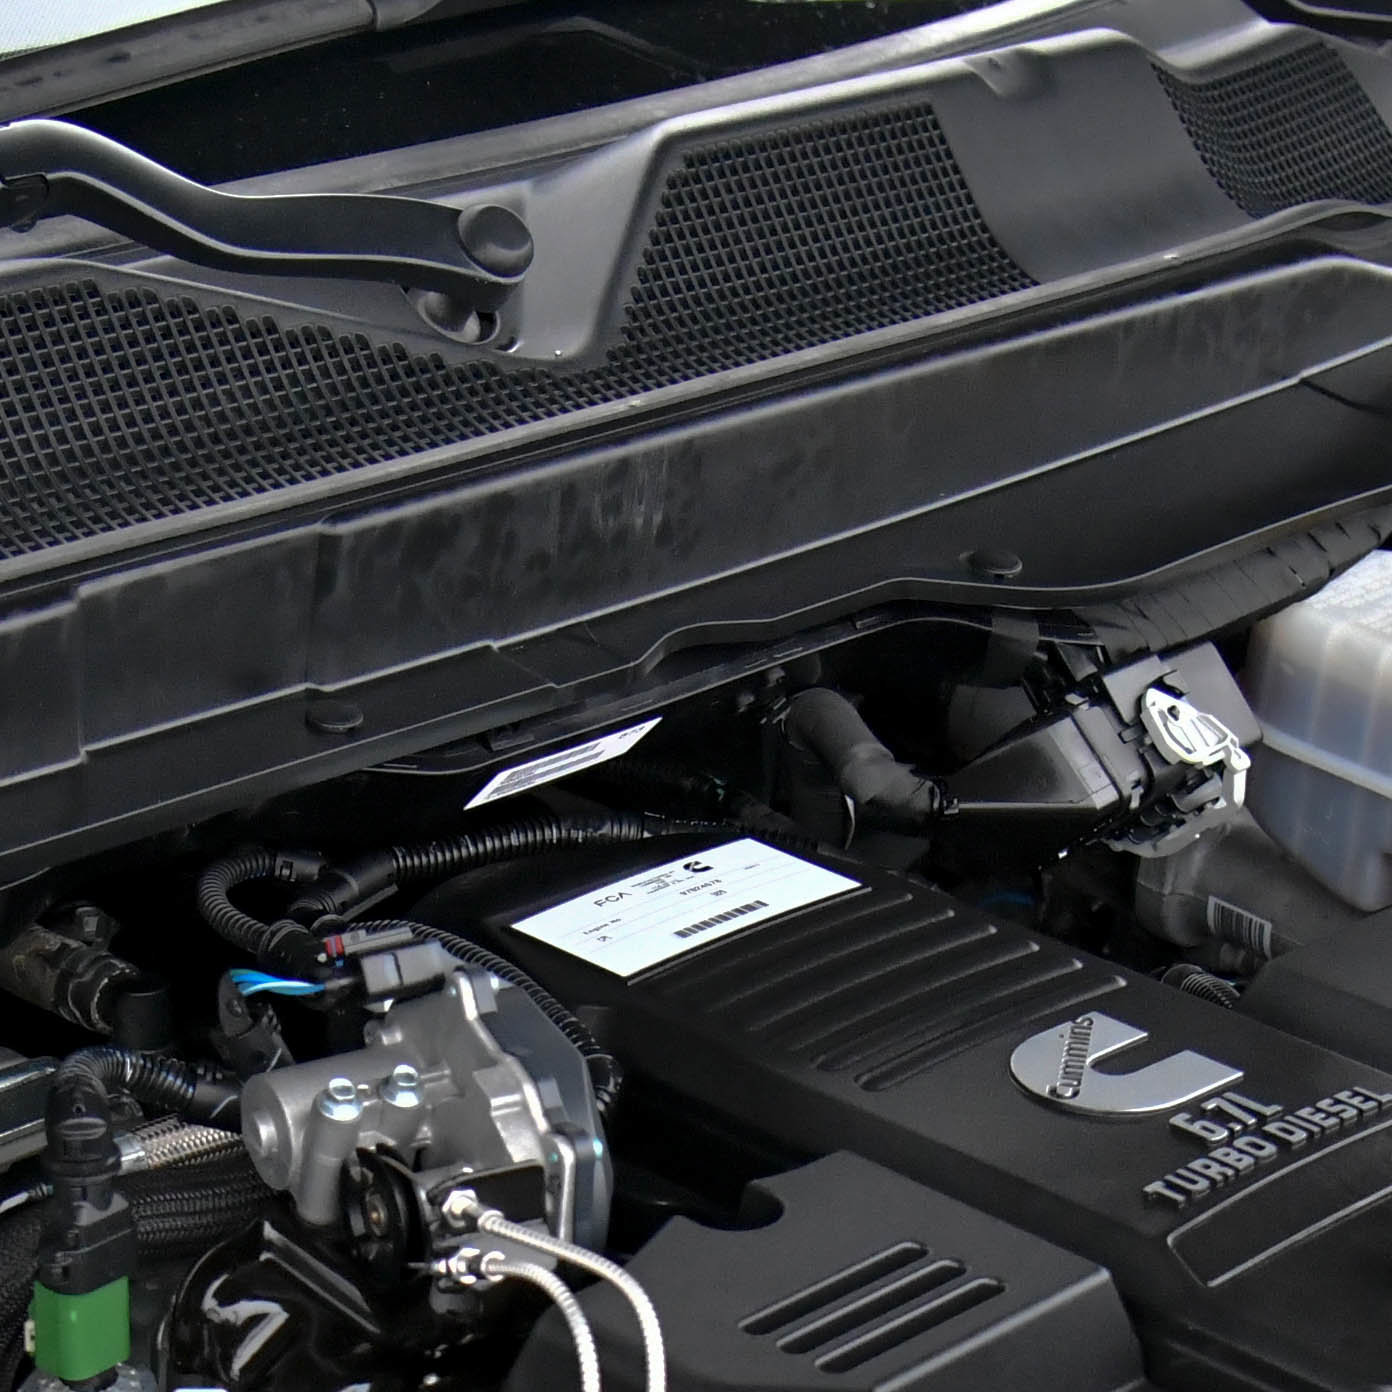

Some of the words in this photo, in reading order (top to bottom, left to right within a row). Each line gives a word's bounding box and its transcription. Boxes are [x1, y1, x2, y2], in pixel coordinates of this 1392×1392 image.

[593, 891, 632, 907] FCA
[1046, 1016, 1094, 1099] Cummins
[1168, 1091, 1285, 1145] 6.7L
[1143, 1135, 1279, 1208] TURBO
